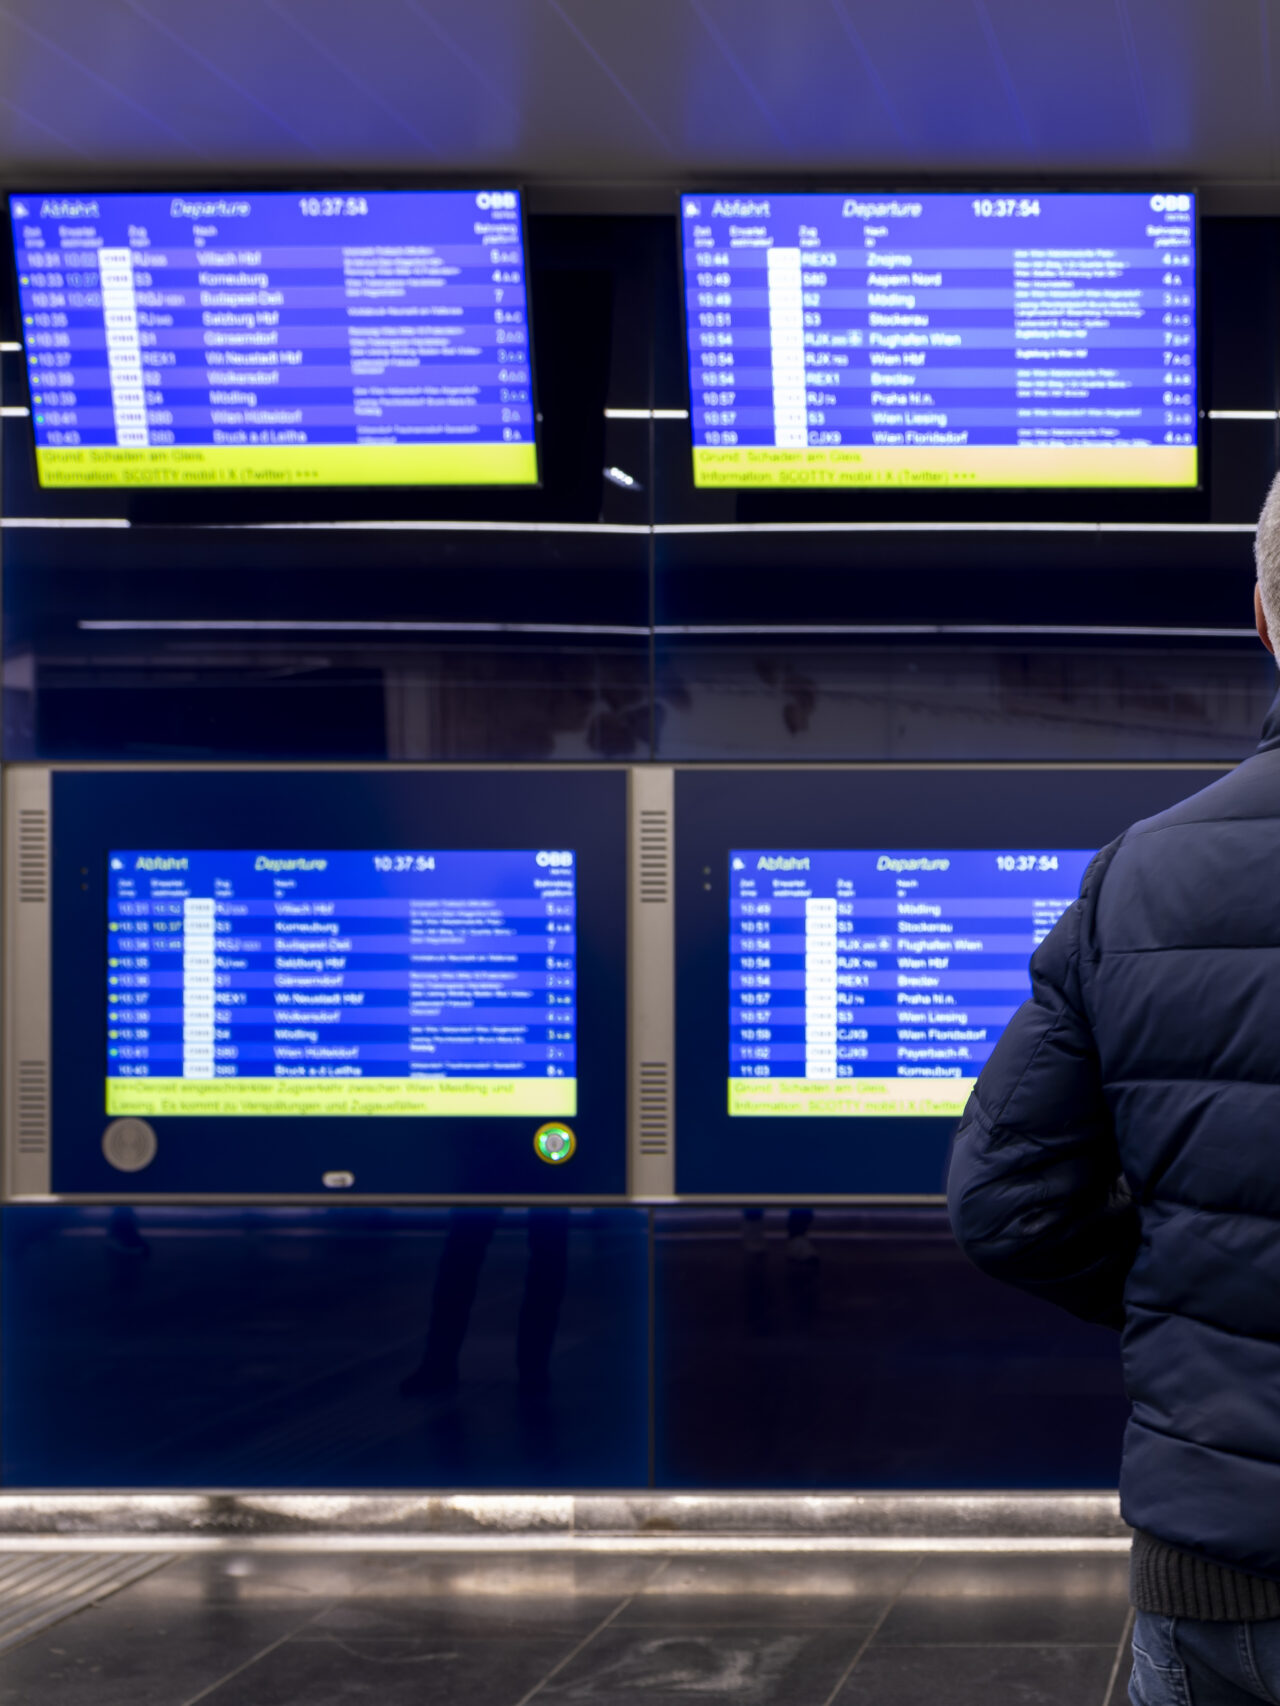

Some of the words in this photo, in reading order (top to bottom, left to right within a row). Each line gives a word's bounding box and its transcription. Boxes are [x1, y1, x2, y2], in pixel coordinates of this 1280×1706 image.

[40, 200, 100, 218] Abfahrt
[170, 199, 251, 220] Departure
[298, 198, 368, 216] 10:37:54
[712, 201, 770, 218] Abfahrt
[842, 200, 922, 220] Departure
[972, 199, 1040, 217] 10:37:54
[135, 856, 188, 871] Abfahrt
[255, 856, 327, 872] Departure
[373, 856, 435, 872] 10:37:54
[757, 856, 811, 872] Abfahrt
[877, 856, 950, 874] Departure
[996, 856, 1058, 871] 10:37:54
